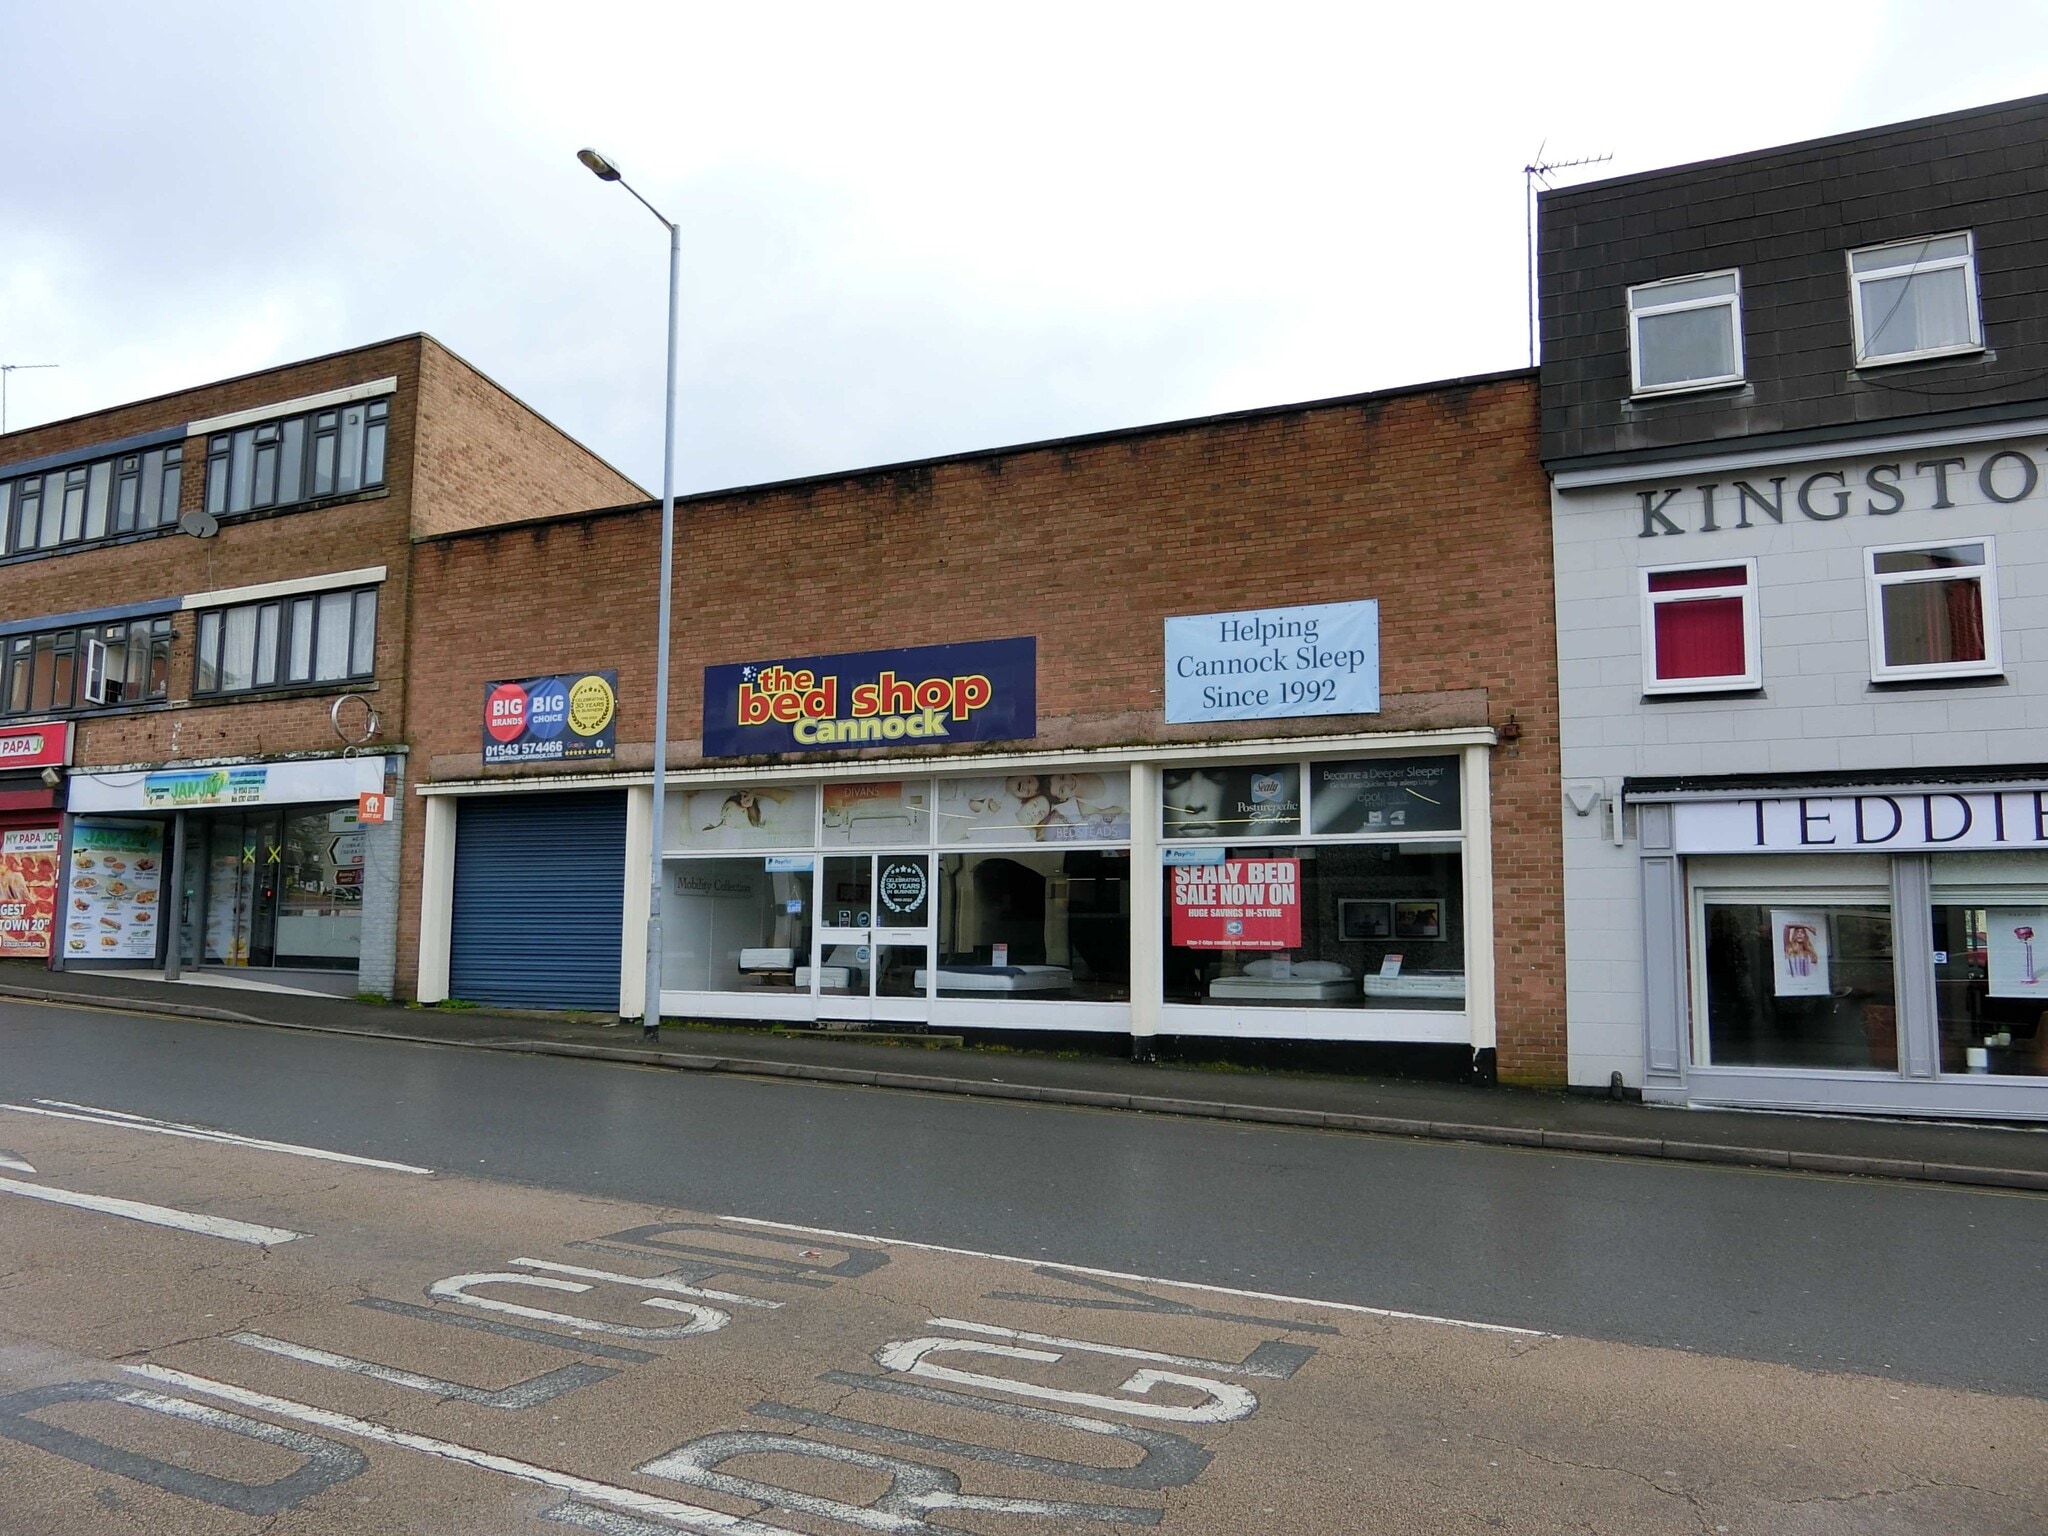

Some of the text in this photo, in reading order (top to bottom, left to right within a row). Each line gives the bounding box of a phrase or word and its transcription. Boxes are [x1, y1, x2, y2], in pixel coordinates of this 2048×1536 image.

[1637, 450, 2048, 538] KINGSTO
[1219, 617, 1319, 647] Helping
[1177, 645, 1365, 678] Cannock Sleep
[758, 665, 814, 694] the
[737, 671, 992, 726] bed shop
[1203, 679, 1337, 709] Since 1992
[493, 699, 523, 716] BIG
[532, 695, 564, 713] BIG
[492, 717, 523, 727] BRANDS
[532, 714, 563, 724] CHOICE
[792, 706, 950, 745] Cannock
[2, 739, 31, 754] PAPA
[485, 741, 563, 757] 01543 574466
[1323, 770, 1361, 780] Become
[1369, 768, 1404, 780] Deeper
[1406, 766, 1444, 779] Sleeper
[844, 786, 880, 798] DIVANS
[1255, 781, 1279, 794] Sealy
[1237, 800, 1298, 814] Posturepedic
[6, 834, 18, 845] MY
[20, 832, 41, 844] PAPA
[1173, 850, 1196, 858] PayPal
[1175, 862, 1295, 885] SEALY BED
[677, 877, 713, 892] Mobility
[1175, 883, 1295, 905] SALE NOW ON
[1188, 908, 1282, 917] HUGE SAVINGS IN-STORE
[0, 918, 30, 931] TOWN
